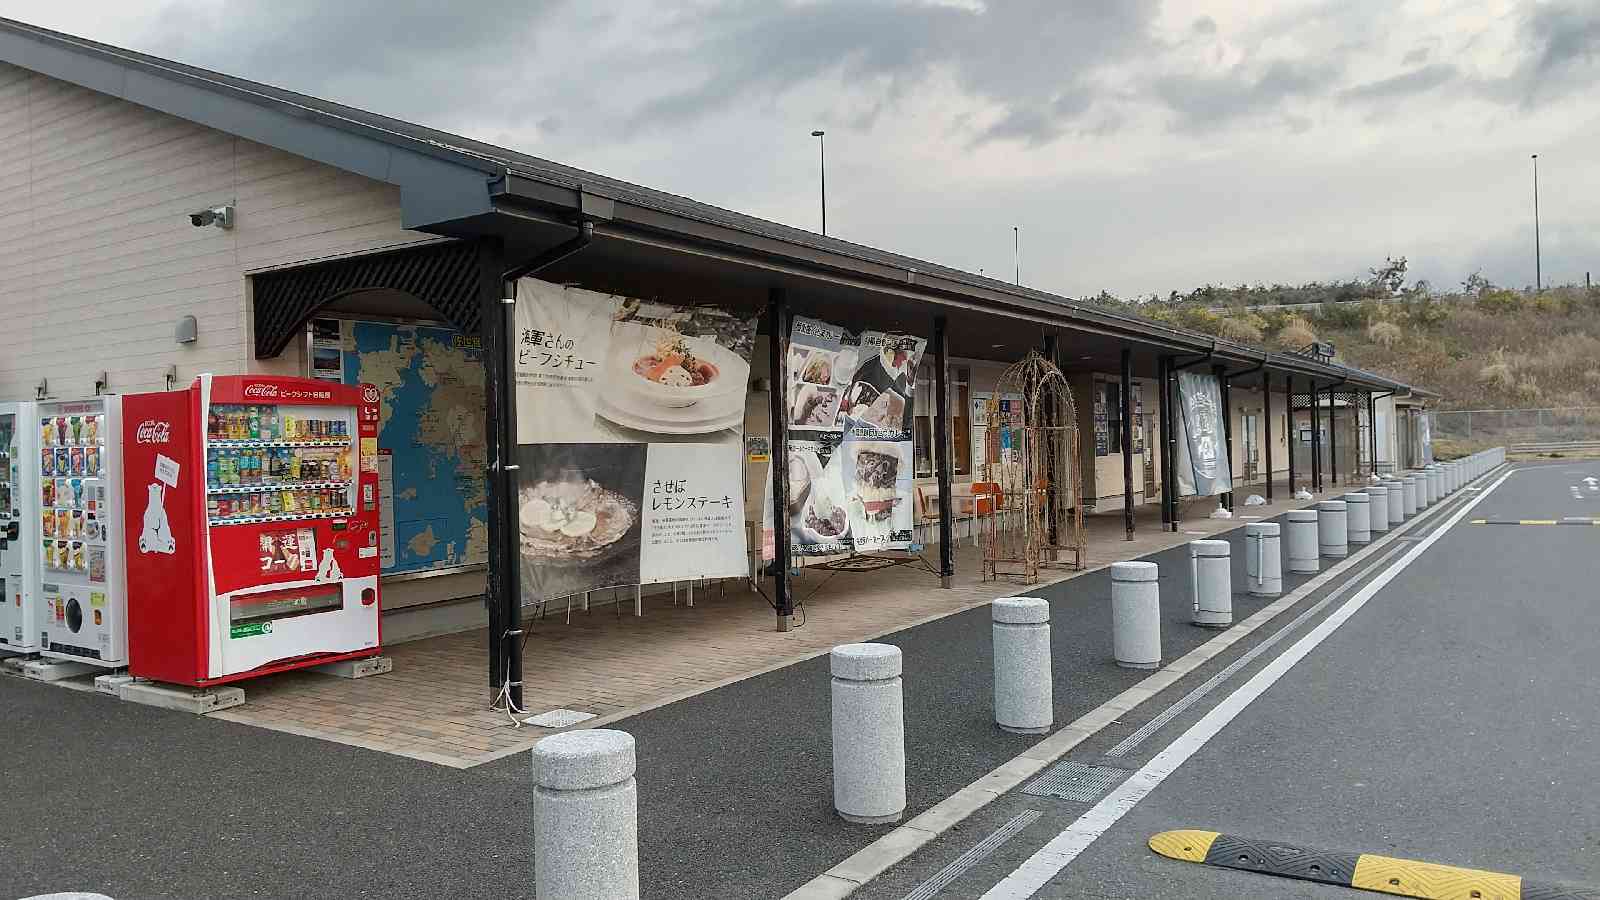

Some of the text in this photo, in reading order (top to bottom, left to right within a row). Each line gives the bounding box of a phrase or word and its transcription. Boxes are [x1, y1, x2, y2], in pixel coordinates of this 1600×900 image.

[518, 349, 598, 370] ビーフシチュー
[653, 479, 687, 494] させぼ
[652, 495, 733, 511] レモンステーキ
